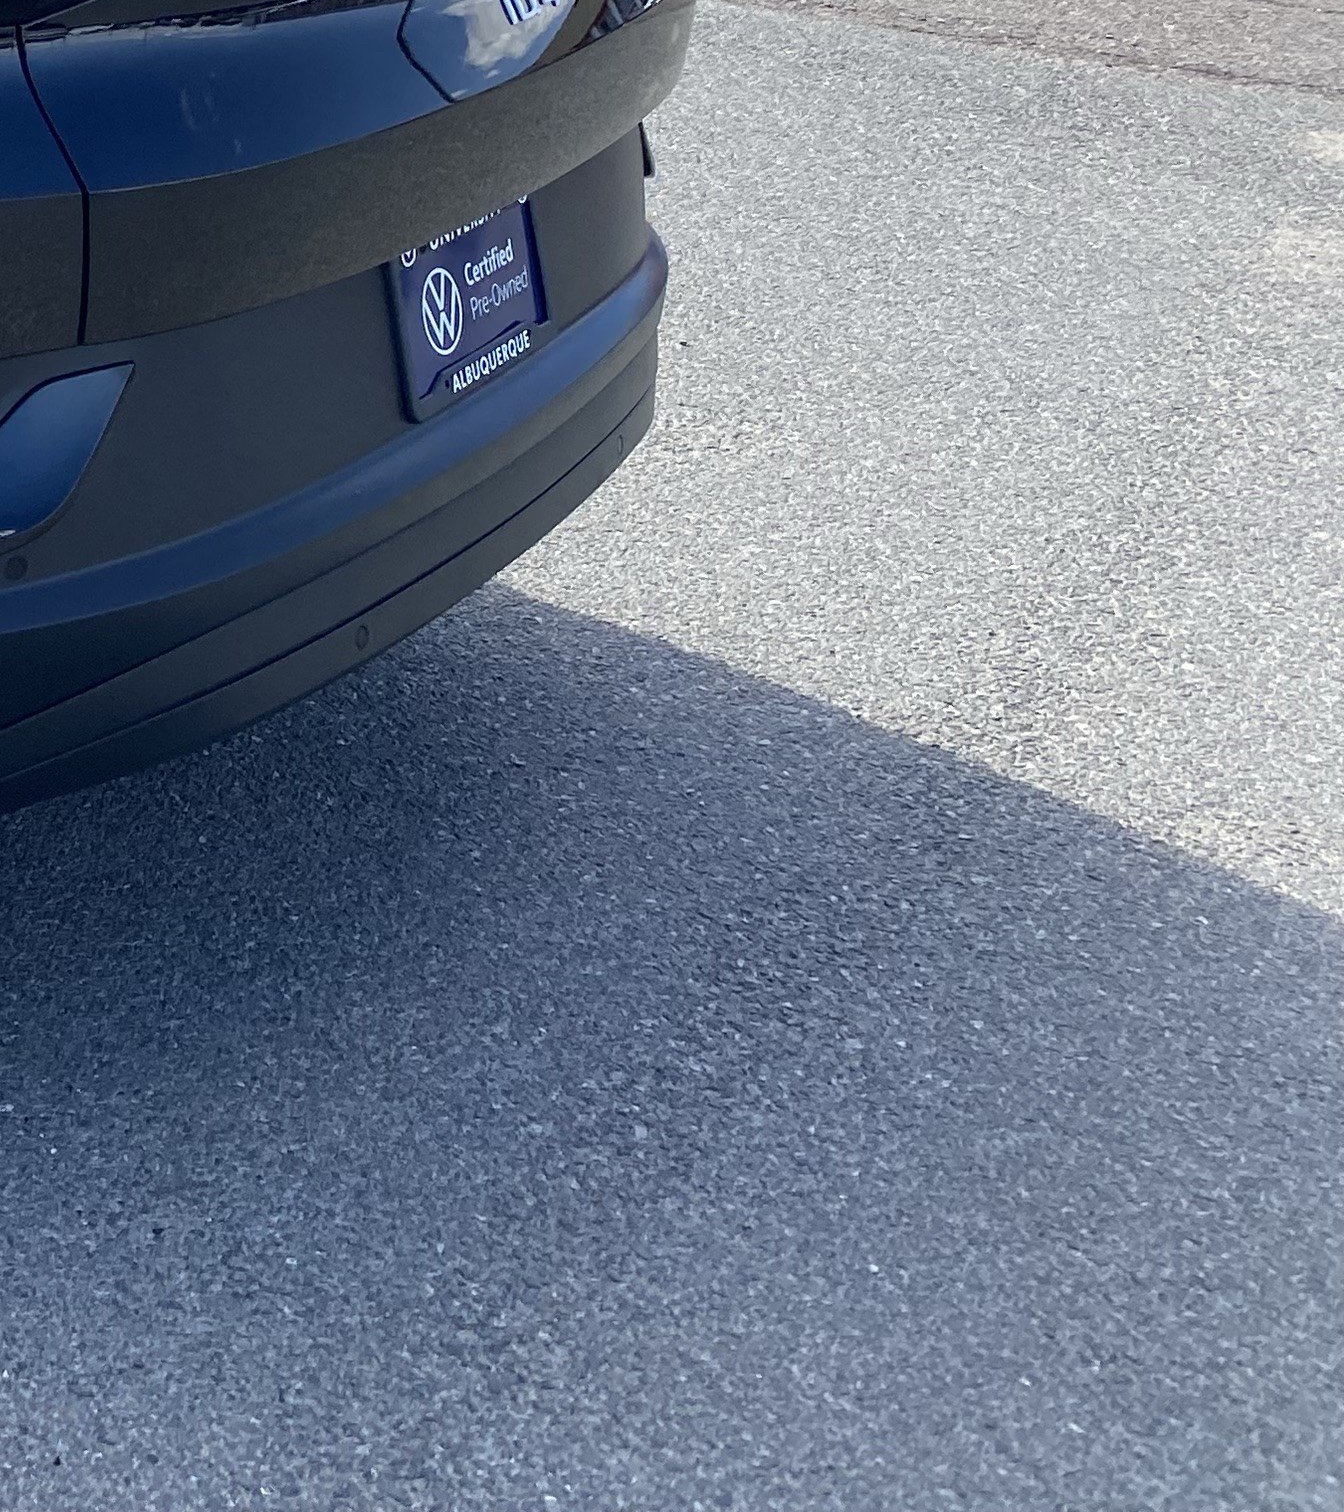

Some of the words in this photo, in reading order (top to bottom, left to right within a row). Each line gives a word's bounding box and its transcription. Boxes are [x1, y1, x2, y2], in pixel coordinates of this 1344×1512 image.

[464, 238, 514, 286] Certified
[469, 265, 529, 320] Pre-Owned
[451, 329, 531, 393] ALBUQUERQUE
